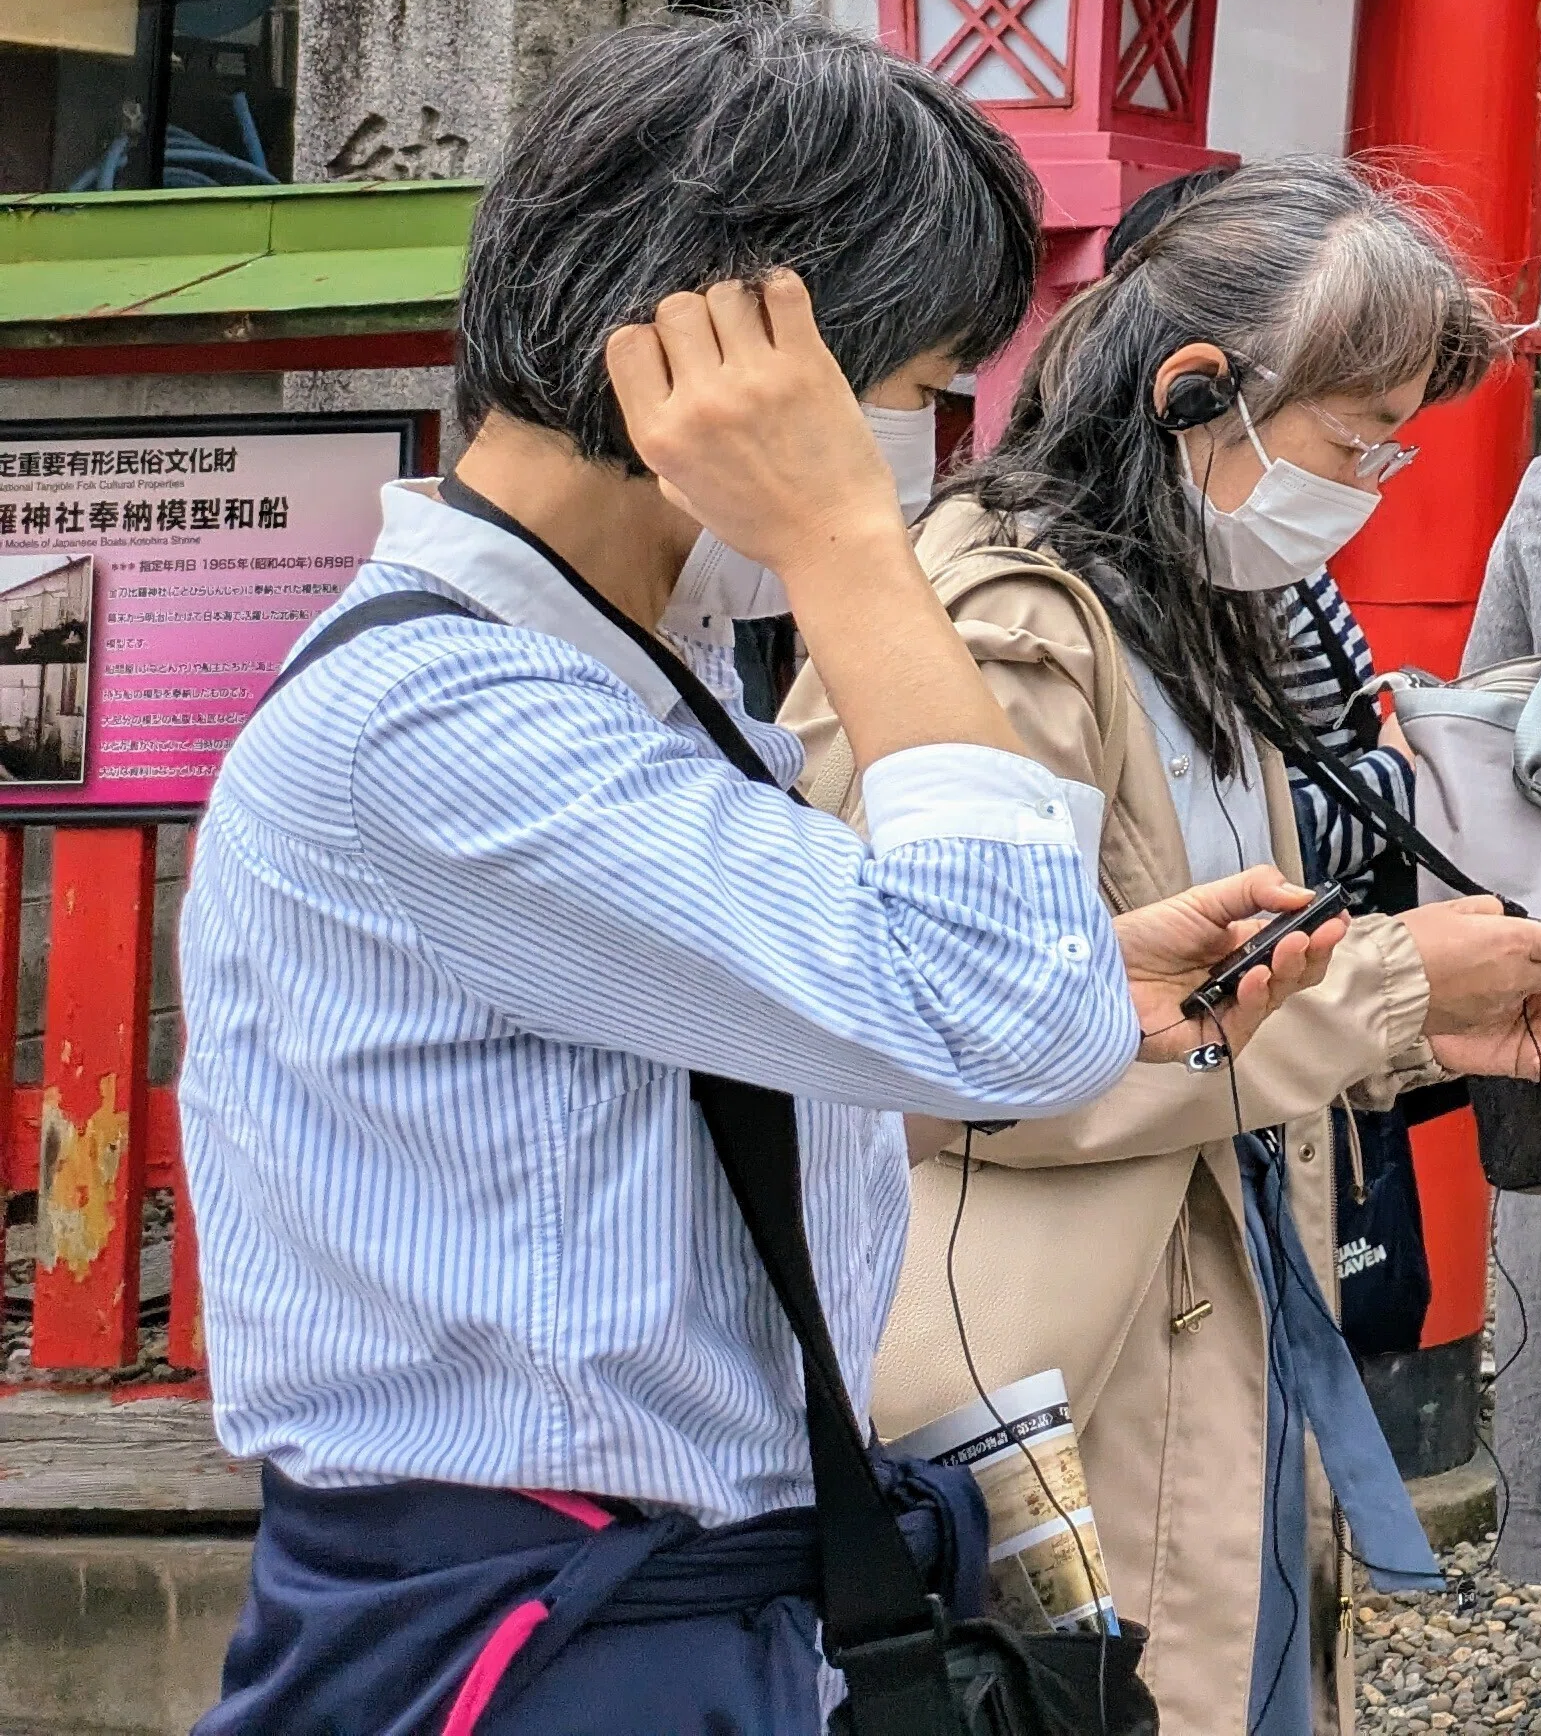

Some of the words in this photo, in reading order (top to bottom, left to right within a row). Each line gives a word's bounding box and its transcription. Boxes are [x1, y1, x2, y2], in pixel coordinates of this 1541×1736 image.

[77, 480, 97, 491] Folk
[99, 479, 135, 491] Cultural
[138, 478, 185, 491] Properties
[3, 538, 39, 549] Models
[41, 537, 51, 548] of
[52, 537, 98, 550] Japanese
[139, 558, 197, 573] 指定年月日
[1189, 1045, 1218, 1069] CE
